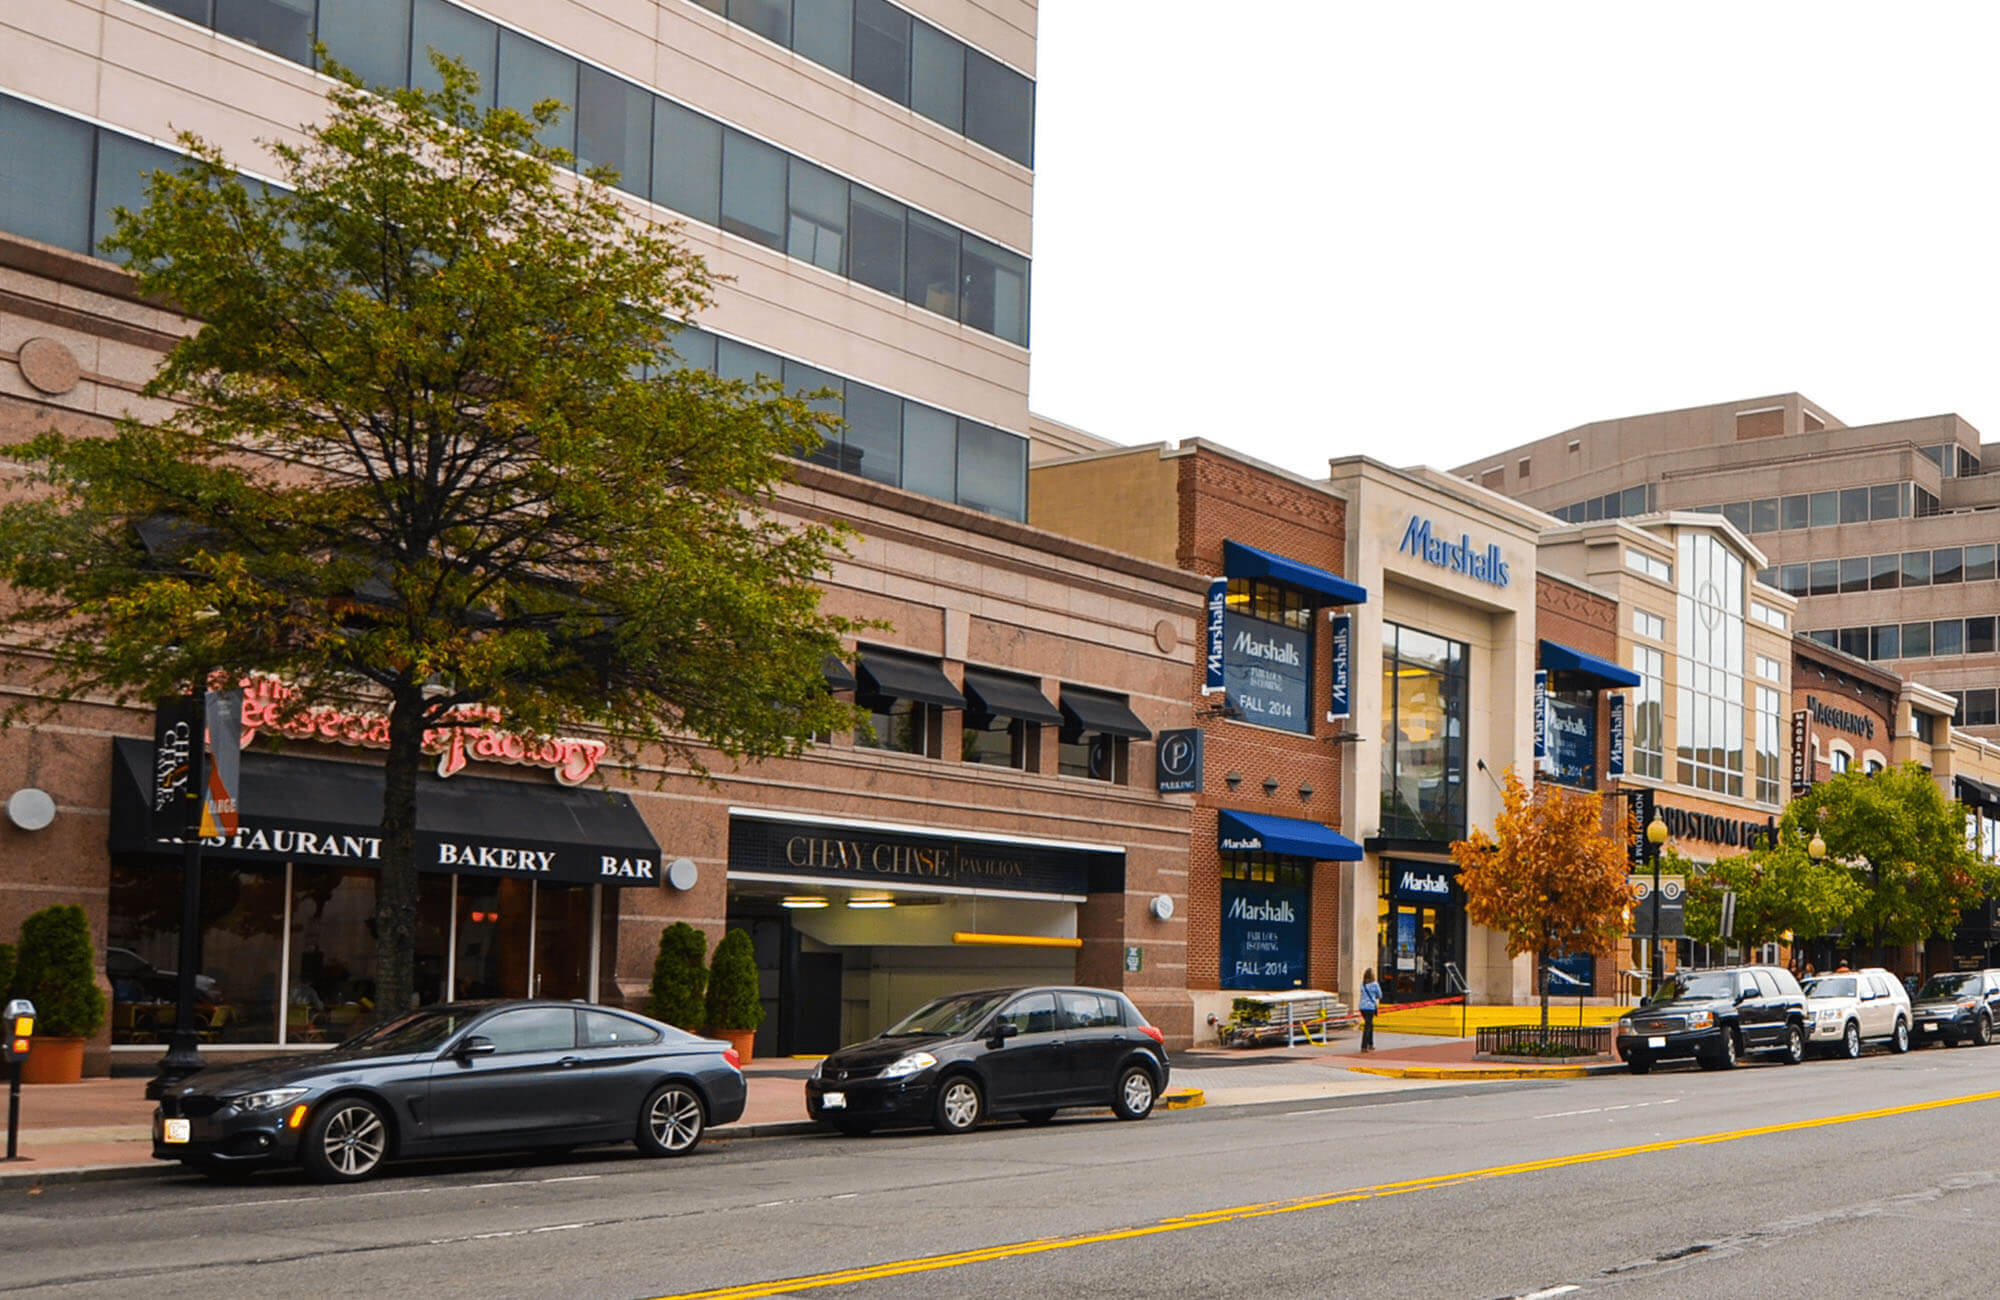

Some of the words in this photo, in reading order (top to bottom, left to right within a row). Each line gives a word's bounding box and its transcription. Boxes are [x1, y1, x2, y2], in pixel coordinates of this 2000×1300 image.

[1400, 515, 1509, 587] Marshalls
[1208, 593, 1224, 676] Marshalls
[1232, 631, 1300, 666] Marshalls
[1333, 627, 1347, 704] Marshalls
[1240, 694, 1264, 712] FALL
[1268, 700, 1292, 717] 2014
[1611, 704, 1623, 766] Marshalls
[1172, 742, 1188, 770] P
[438, 843, 556, 872] BAKERY
[600, 856, 653, 879] BAR
[786, 836, 868, 871] CHEVY
[872, 843, 951, 879] CHASE
[960, 857, 1024, 877] PAVILION
[1220, 838, 1262, 849] Marshalls
[1400, 871, 1449, 894] Marshalls
[1228, 897, 1295, 923] Marshalls
[1235, 961, 1261, 976] FALL
[1265, 961, 1288, 976] 2014
